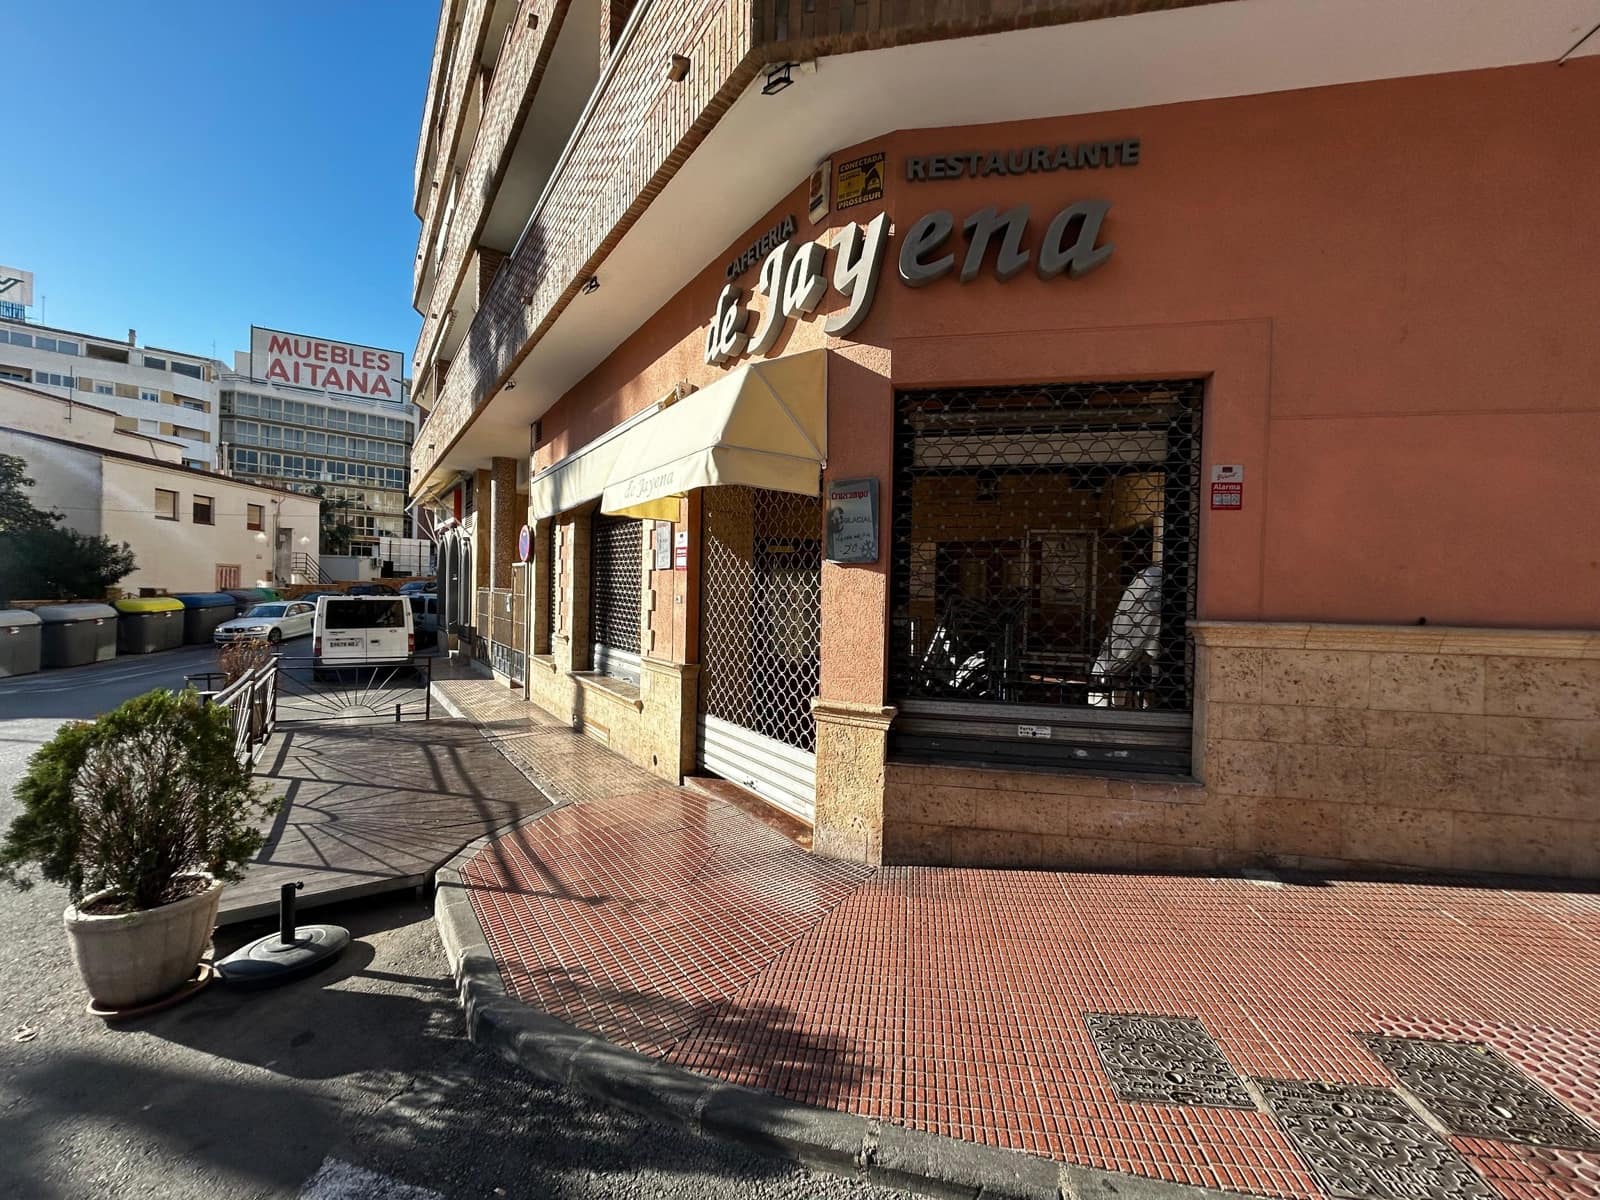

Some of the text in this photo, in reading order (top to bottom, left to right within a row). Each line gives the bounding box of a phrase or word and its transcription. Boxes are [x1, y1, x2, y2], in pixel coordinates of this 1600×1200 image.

[839, 152, 883, 173] CONECTADA
[906, 138, 1140, 182] RESTAURANTE
[838, 191, 881, 209] PROSEGUR
[725, 213, 797, 281] CAFETERIA
[704, 283, 749, 366] de
[268, 335, 391, 372] MUEBLES
[265, 358, 392, 397] AITANA
[1213, 483, 1240, 491] Alarma
